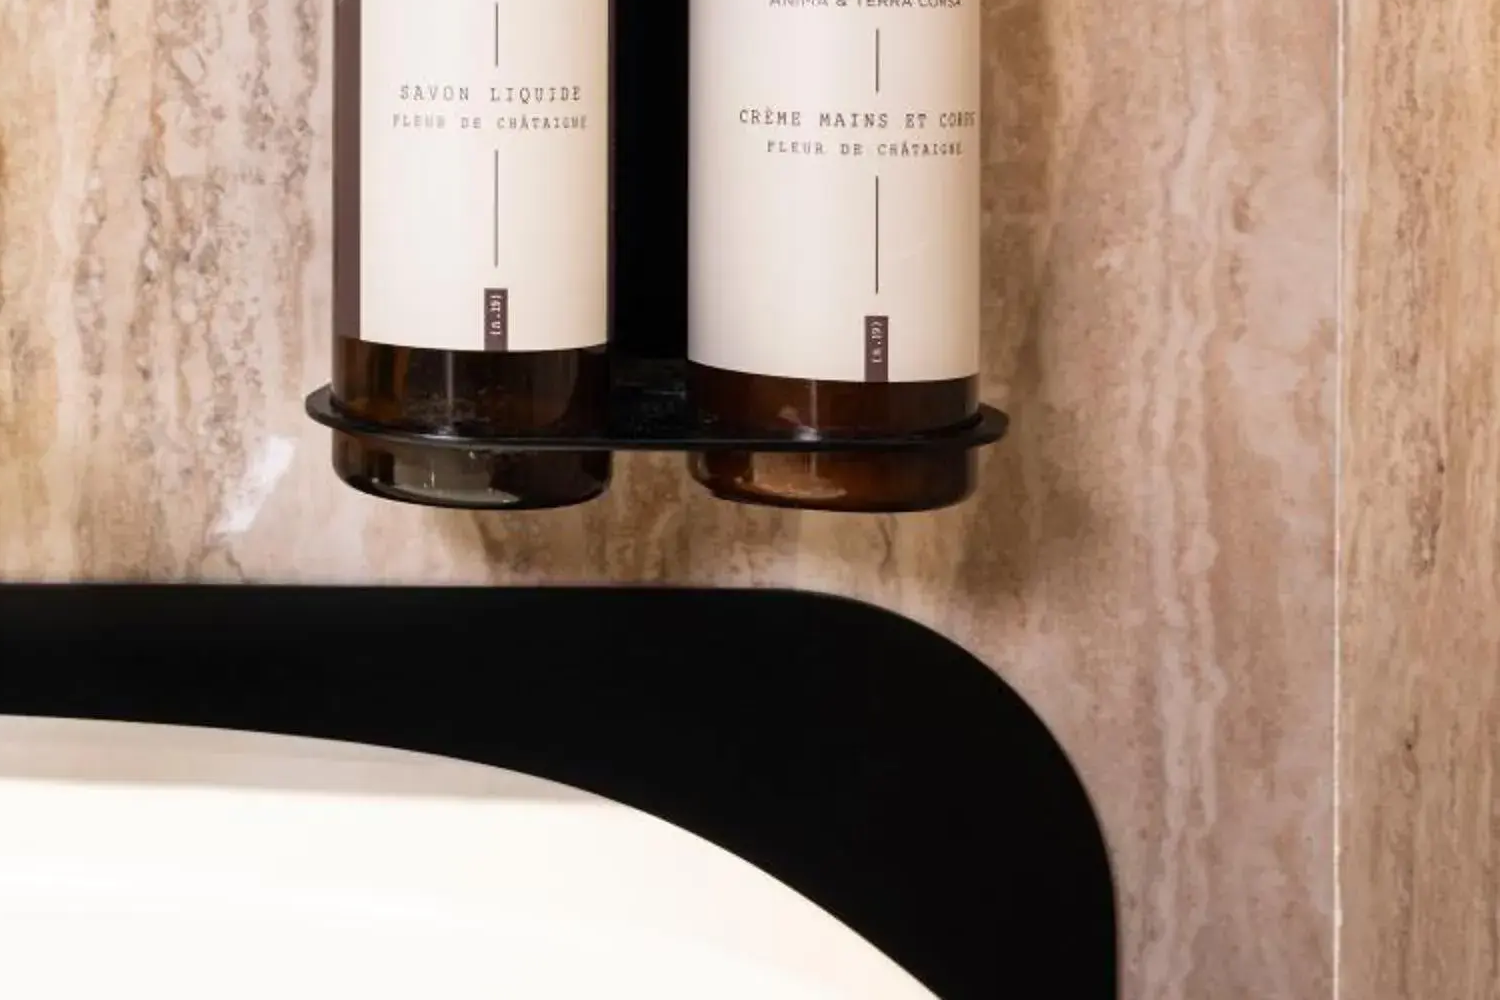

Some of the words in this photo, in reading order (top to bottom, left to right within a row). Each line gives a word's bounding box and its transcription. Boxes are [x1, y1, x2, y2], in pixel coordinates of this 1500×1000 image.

[399, 84, 470, 102] SAVON
[489, 85, 582, 104] LIQUIDE
[461, 116, 482, 130] DE
[739, 105, 802, 127] CRÈME
[819, 112, 889, 129] MAINS
[904, 112, 928, 129] ET
[767, 140, 824, 155] FLEUR
[840, 143, 864, 156] DE
